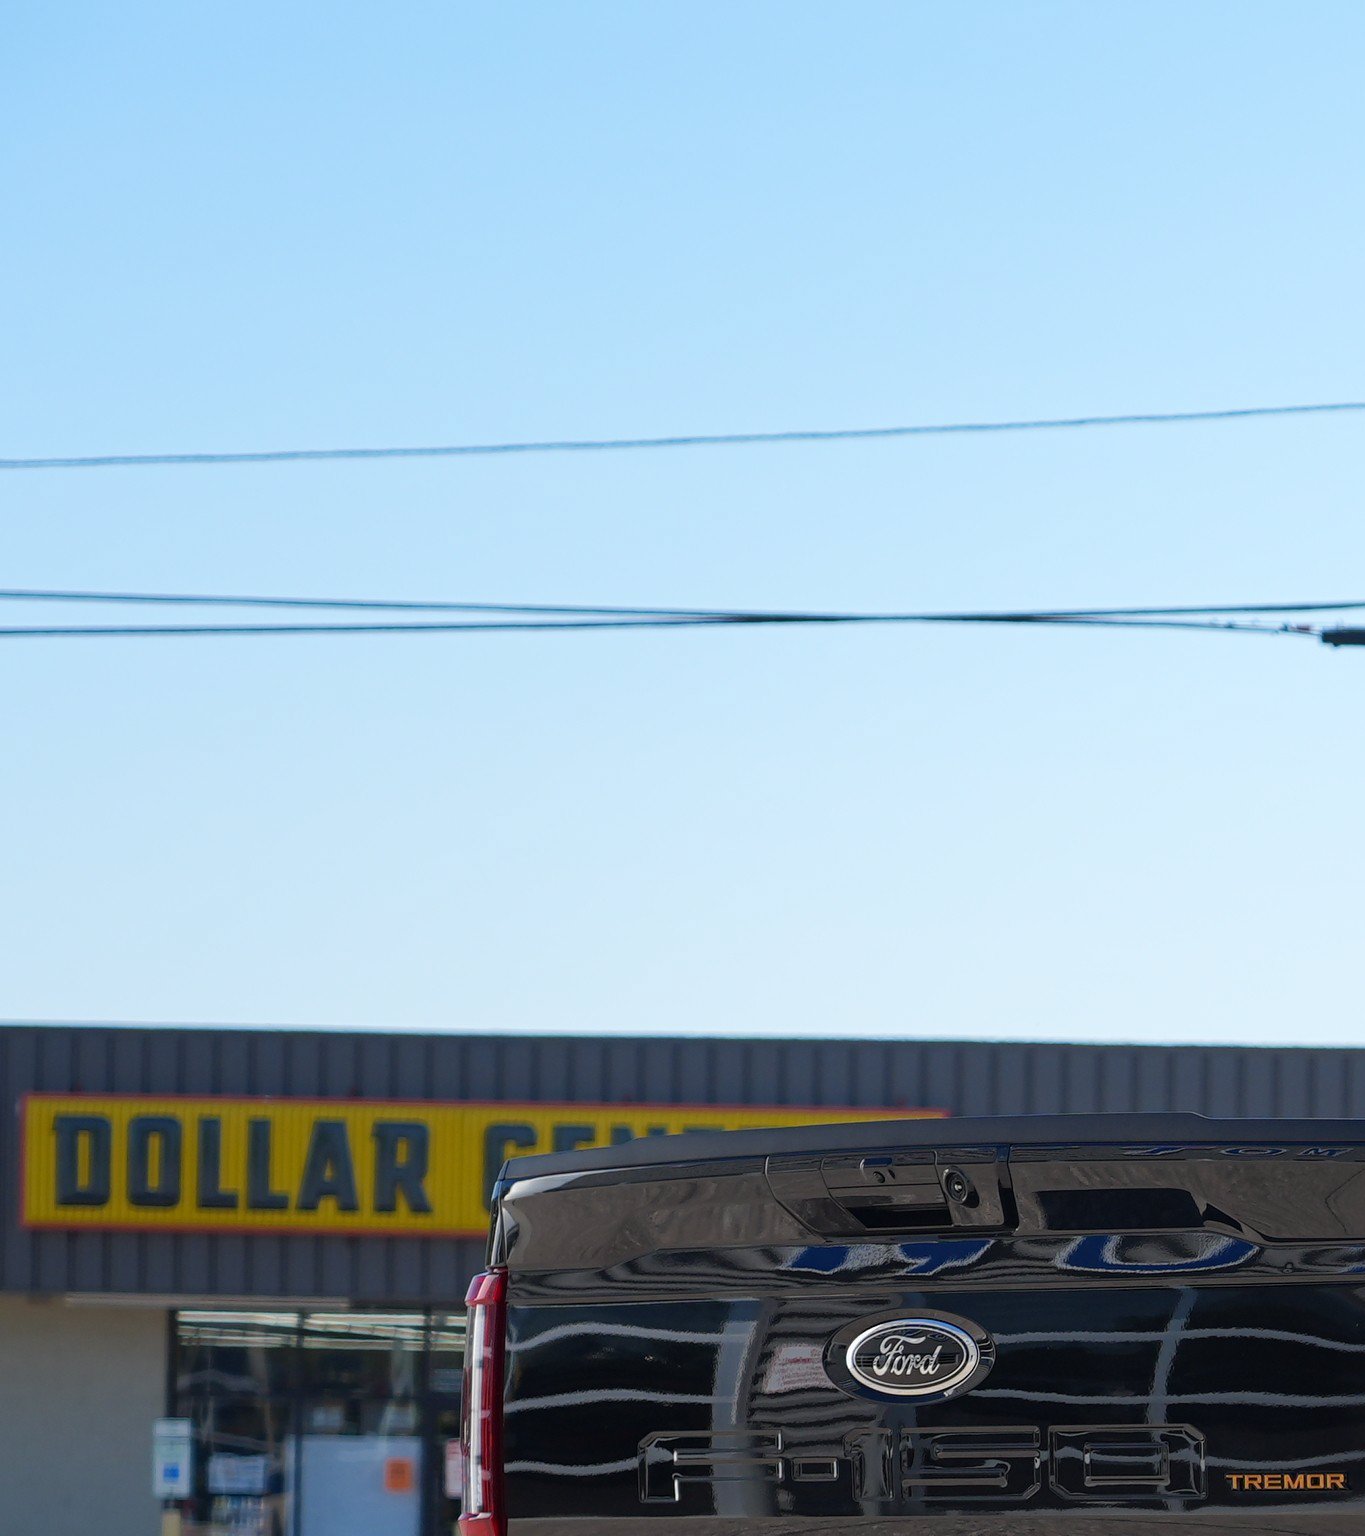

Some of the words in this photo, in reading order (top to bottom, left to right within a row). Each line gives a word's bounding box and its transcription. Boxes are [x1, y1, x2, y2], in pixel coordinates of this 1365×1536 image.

[53, 1113, 433, 1214] DOLLAR
[872, 1334, 943, 1377] Ford
[637, 1425, 1208, 1502] F-150
[1225, 1473, 1346, 1491] TREMOR
